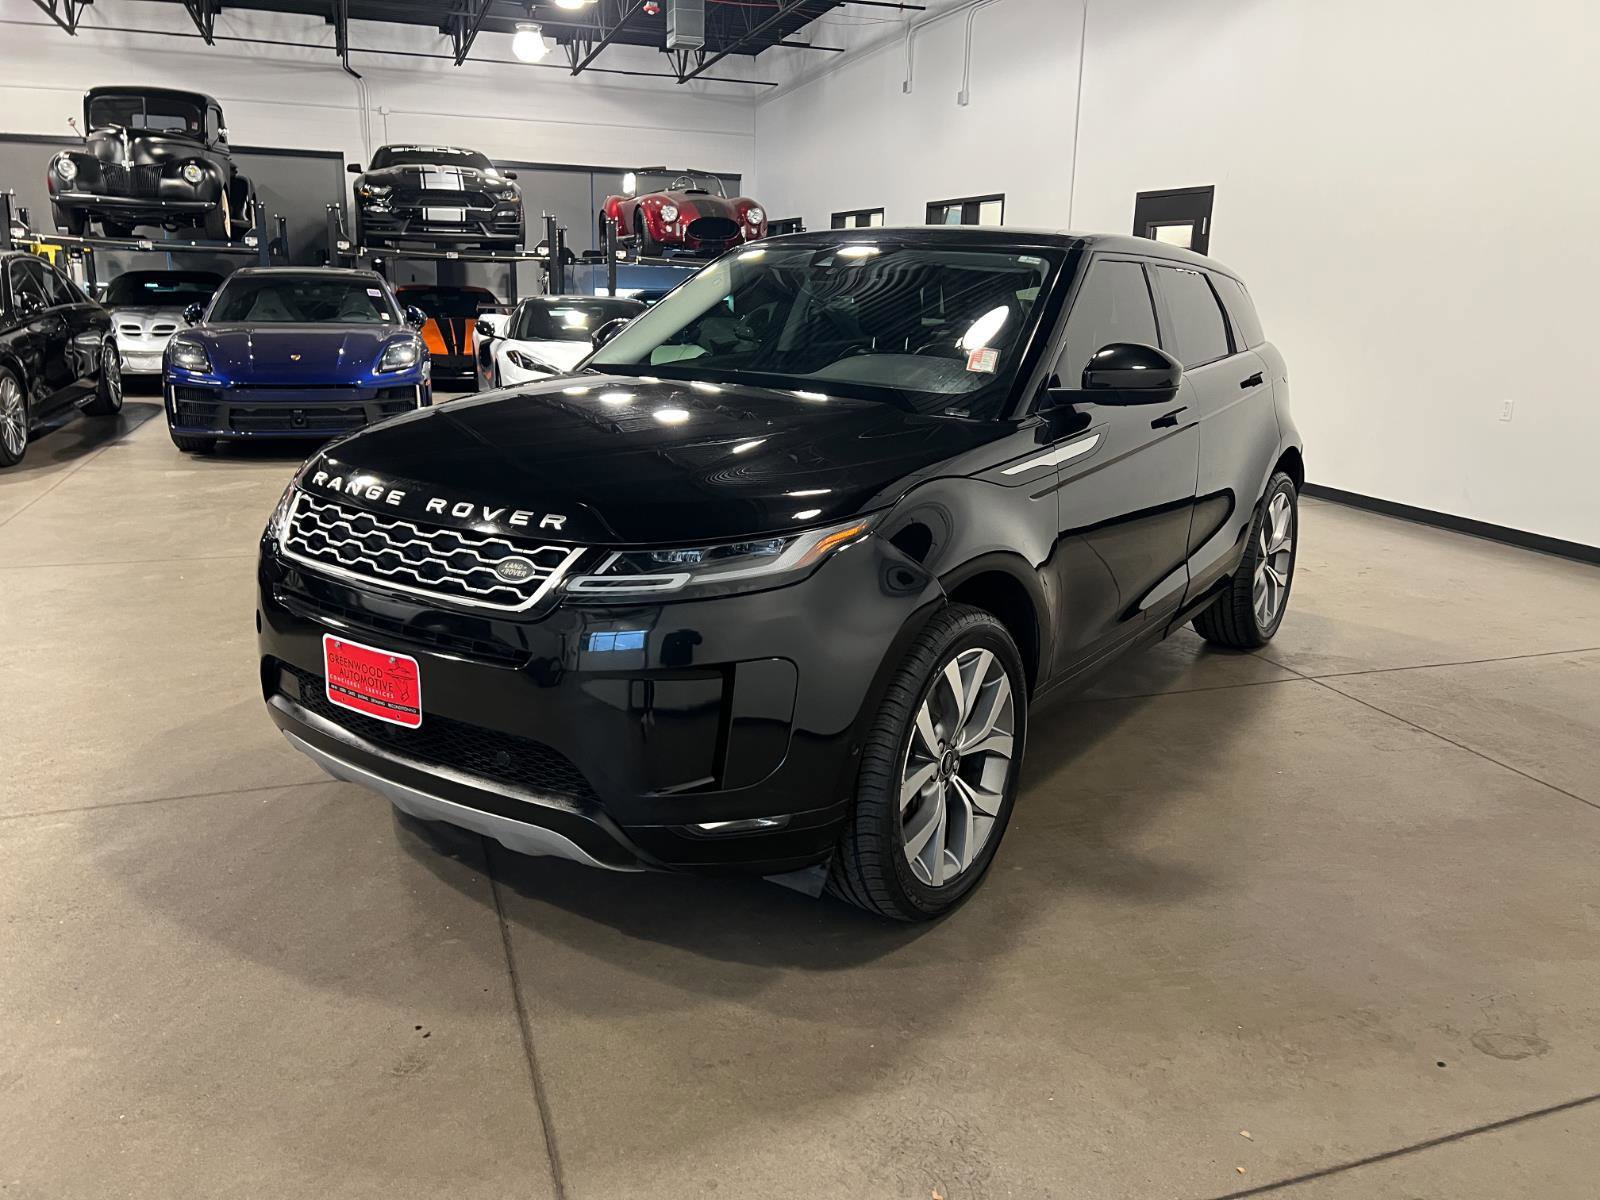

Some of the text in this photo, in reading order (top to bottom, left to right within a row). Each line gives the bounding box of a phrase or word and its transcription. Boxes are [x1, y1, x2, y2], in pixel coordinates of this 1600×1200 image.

[312, 471, 568, 530] RANGE ROVER
[503, 569, 527, 577] ROVER
[328, 652, 383, 678] GREENWOOD
[339, 667, 393, 692] AUTOMOTIVE
[365, 686, 395, 699] SERVICES
